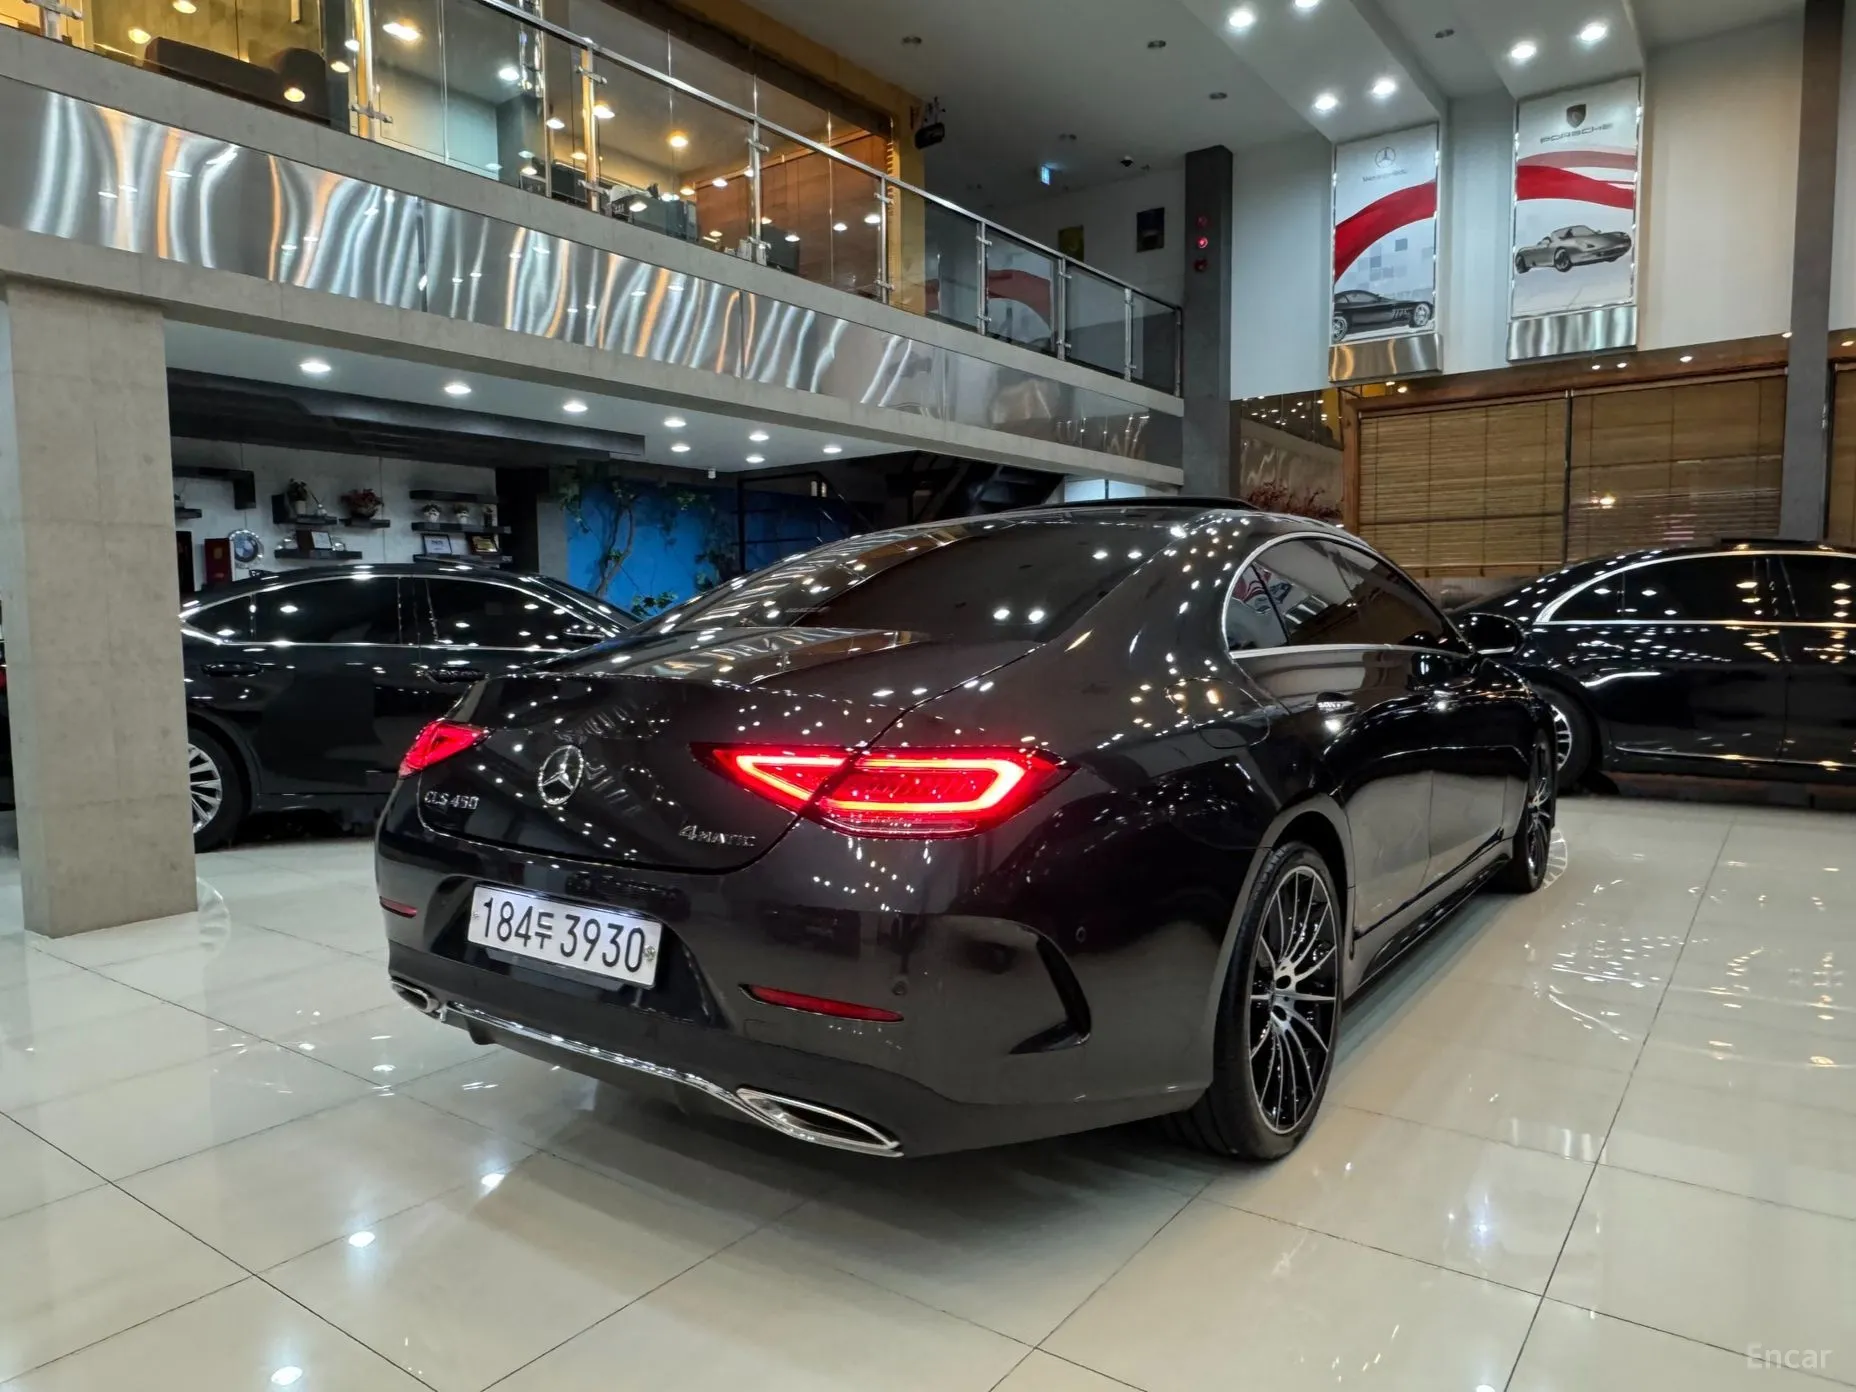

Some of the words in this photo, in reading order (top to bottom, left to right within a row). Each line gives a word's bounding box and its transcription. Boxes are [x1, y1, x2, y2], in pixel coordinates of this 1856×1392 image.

[1540, 123, 1613, 144] PORSCHE
[450, 794, 479, 810] 450
[560, 914, 645, 973] 3930
